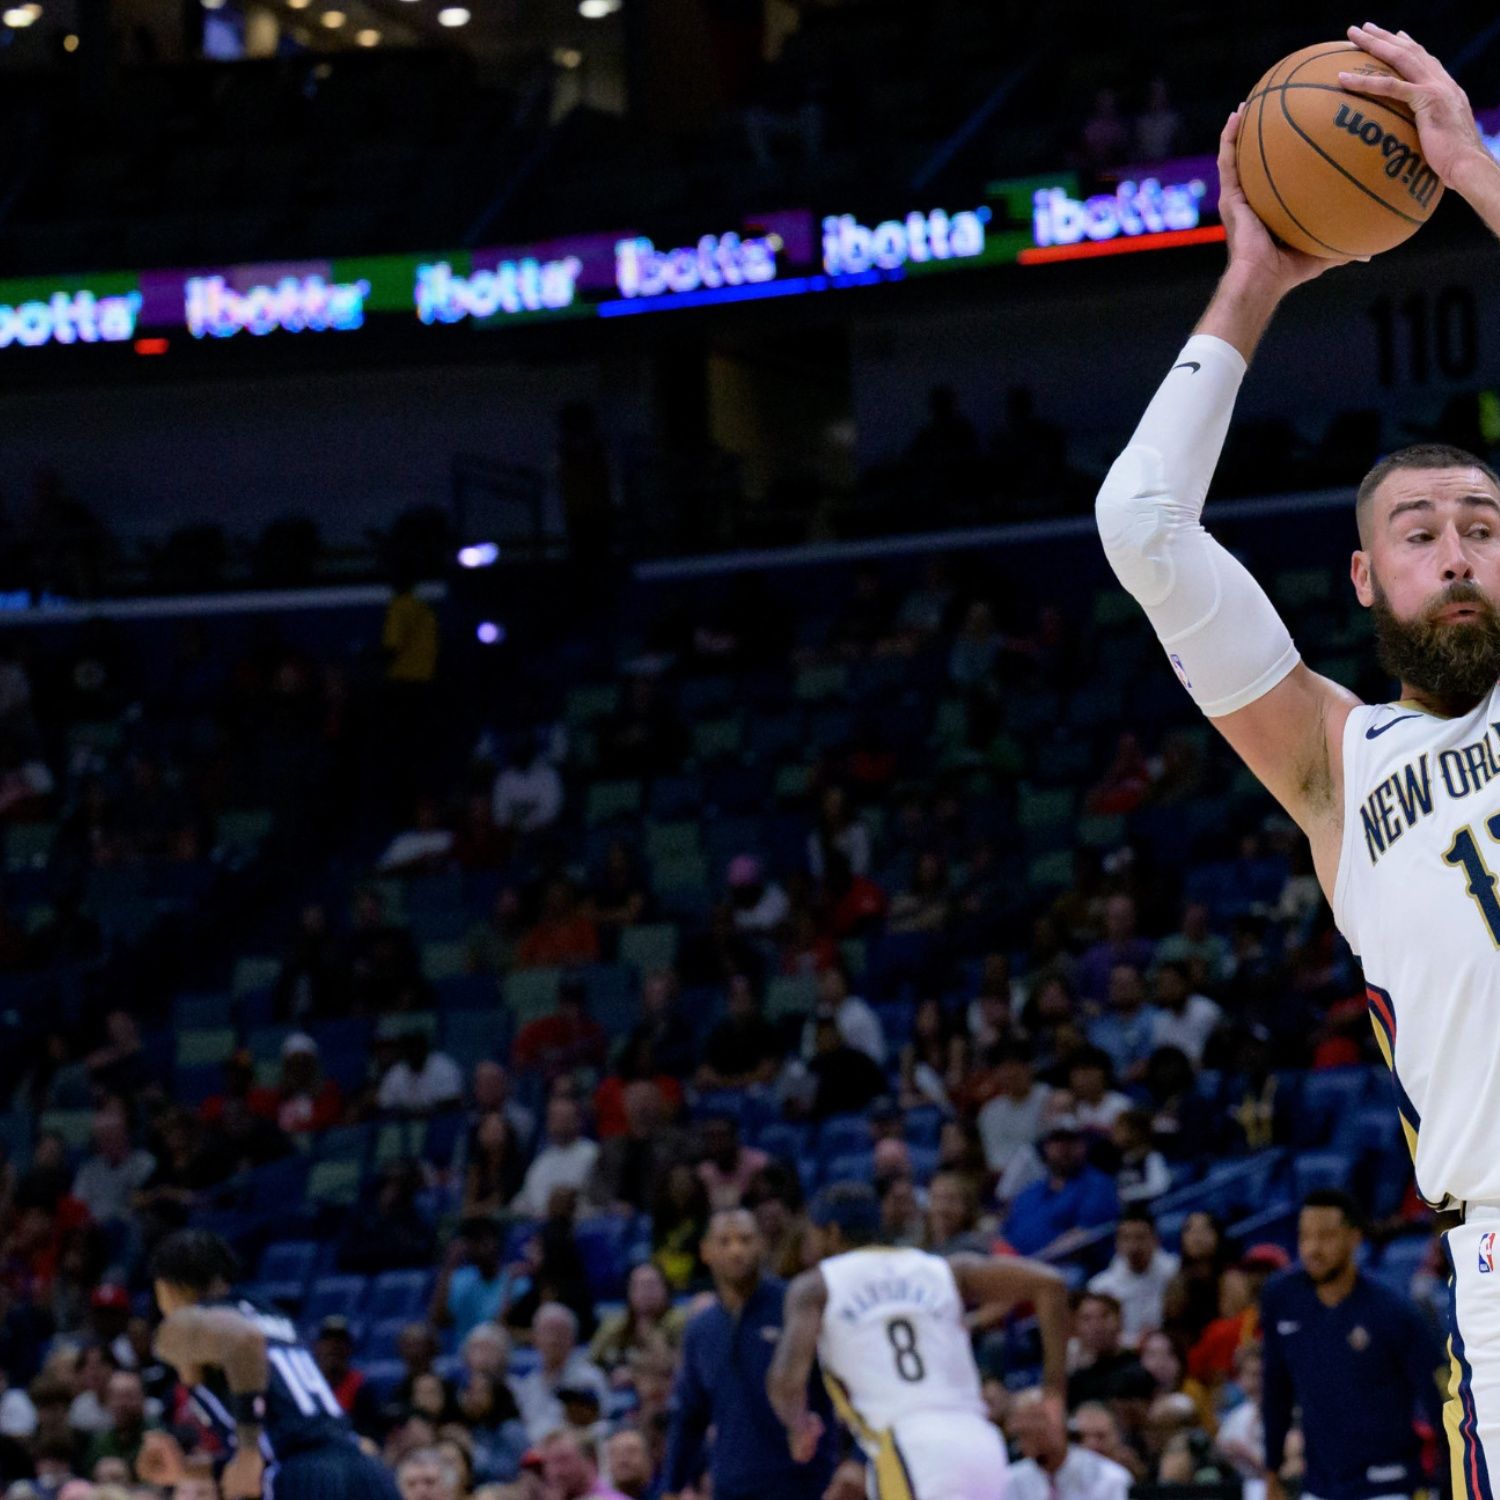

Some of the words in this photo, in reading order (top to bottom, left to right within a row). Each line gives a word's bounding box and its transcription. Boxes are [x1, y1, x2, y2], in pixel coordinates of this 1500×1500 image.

[1333, 103, 1438, 208] Wilson
[822, 208, 986, 276] ibotta
[1033, 179, 1201, 246] ibotta
[416, 256, 576, 323] ibotta
[617, 230, 780, 297] ibotta
[1370, 287, 1476, 384] 110
[1359, 752, 1434, 866] NEW
[885, 1314, 926, 1384] 8
